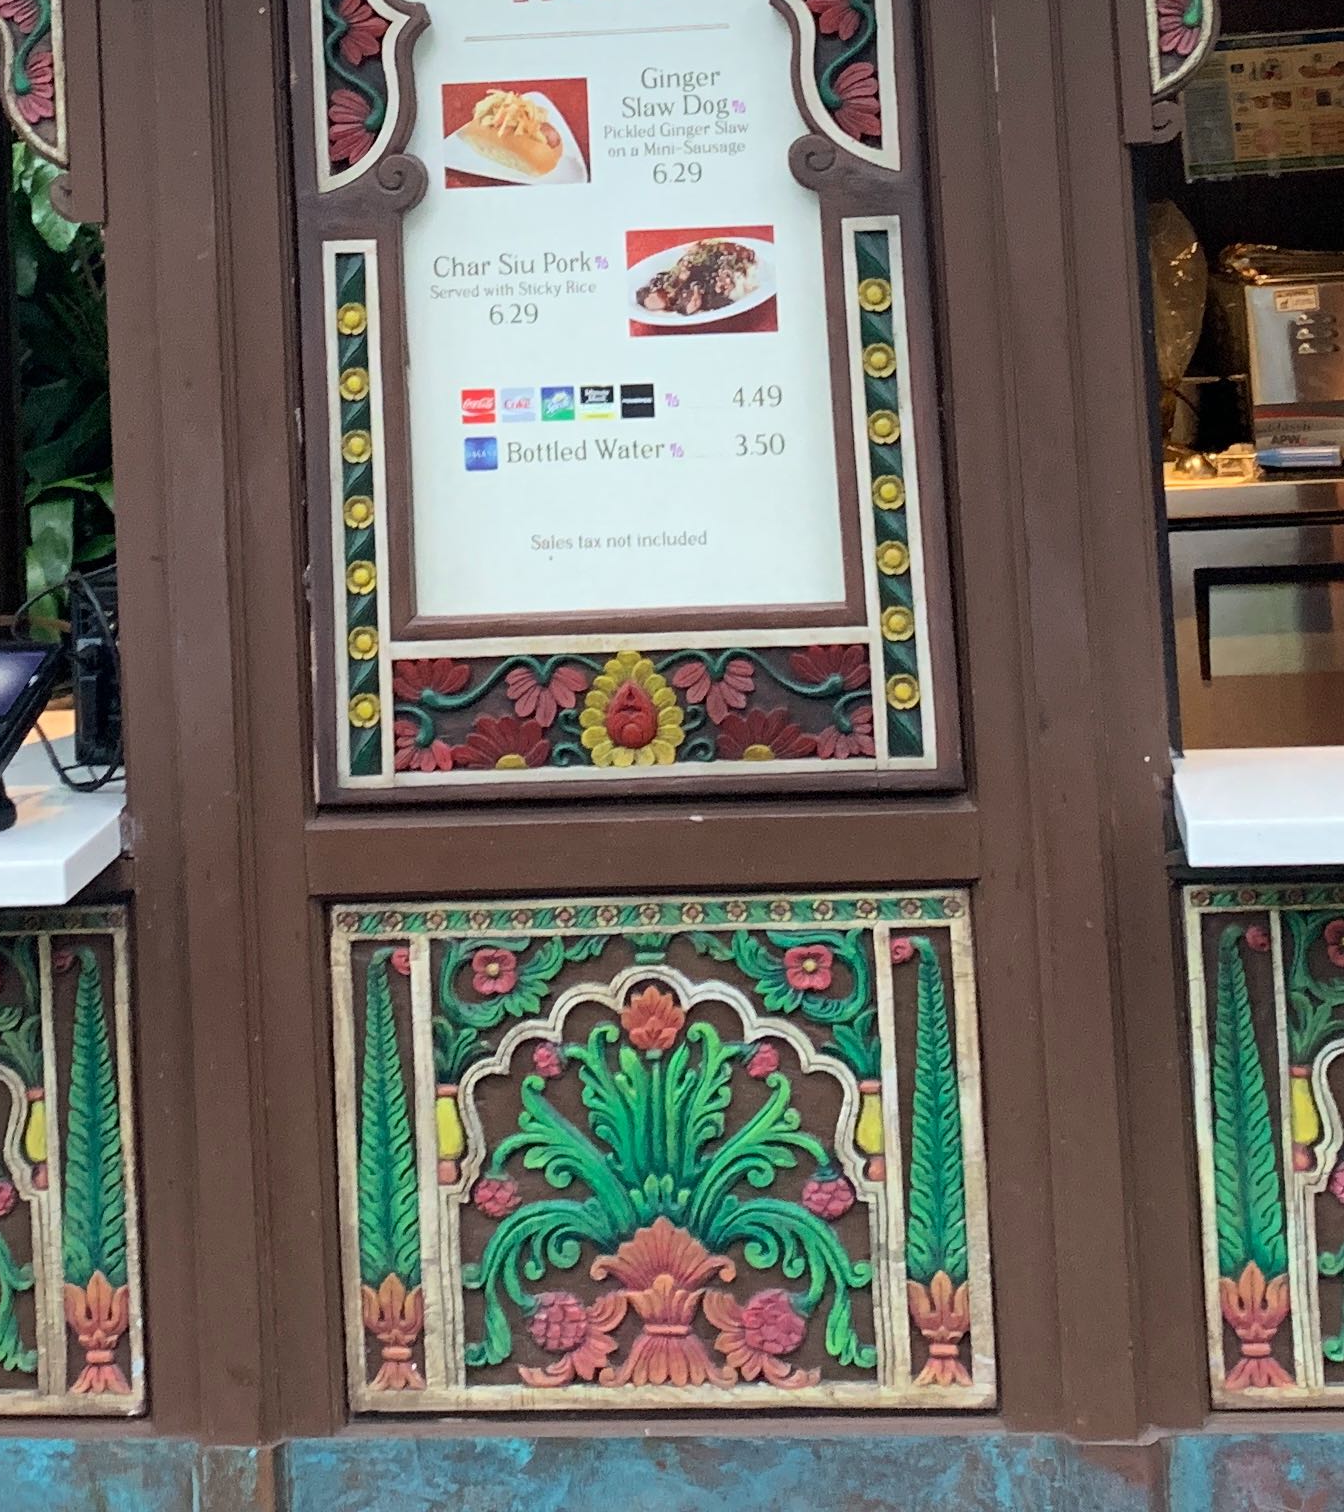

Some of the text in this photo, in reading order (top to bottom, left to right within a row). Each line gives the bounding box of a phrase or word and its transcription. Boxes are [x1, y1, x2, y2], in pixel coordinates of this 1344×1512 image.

[641, 66, 721, 93] Ginger
[621, 94, 731, 120] Slaw Dog
[603, 120, 749, 140] Pickled Ginger Slaw
[607, 140, 747, 159] on a Mini-Sausage
[652, 161, 703, 185] 6.29
[433, 250, 593, 279] Char Siu Pork
[429, 279, 597, 300] Served with Sticky Rice
[489, 302, 539, 326] 6.29
[732, 384, 784, 409] 4.49
[506, 433, 786, 465] Bottled Water 3.50
[530, 530, 708, 552] Sales tax not included
